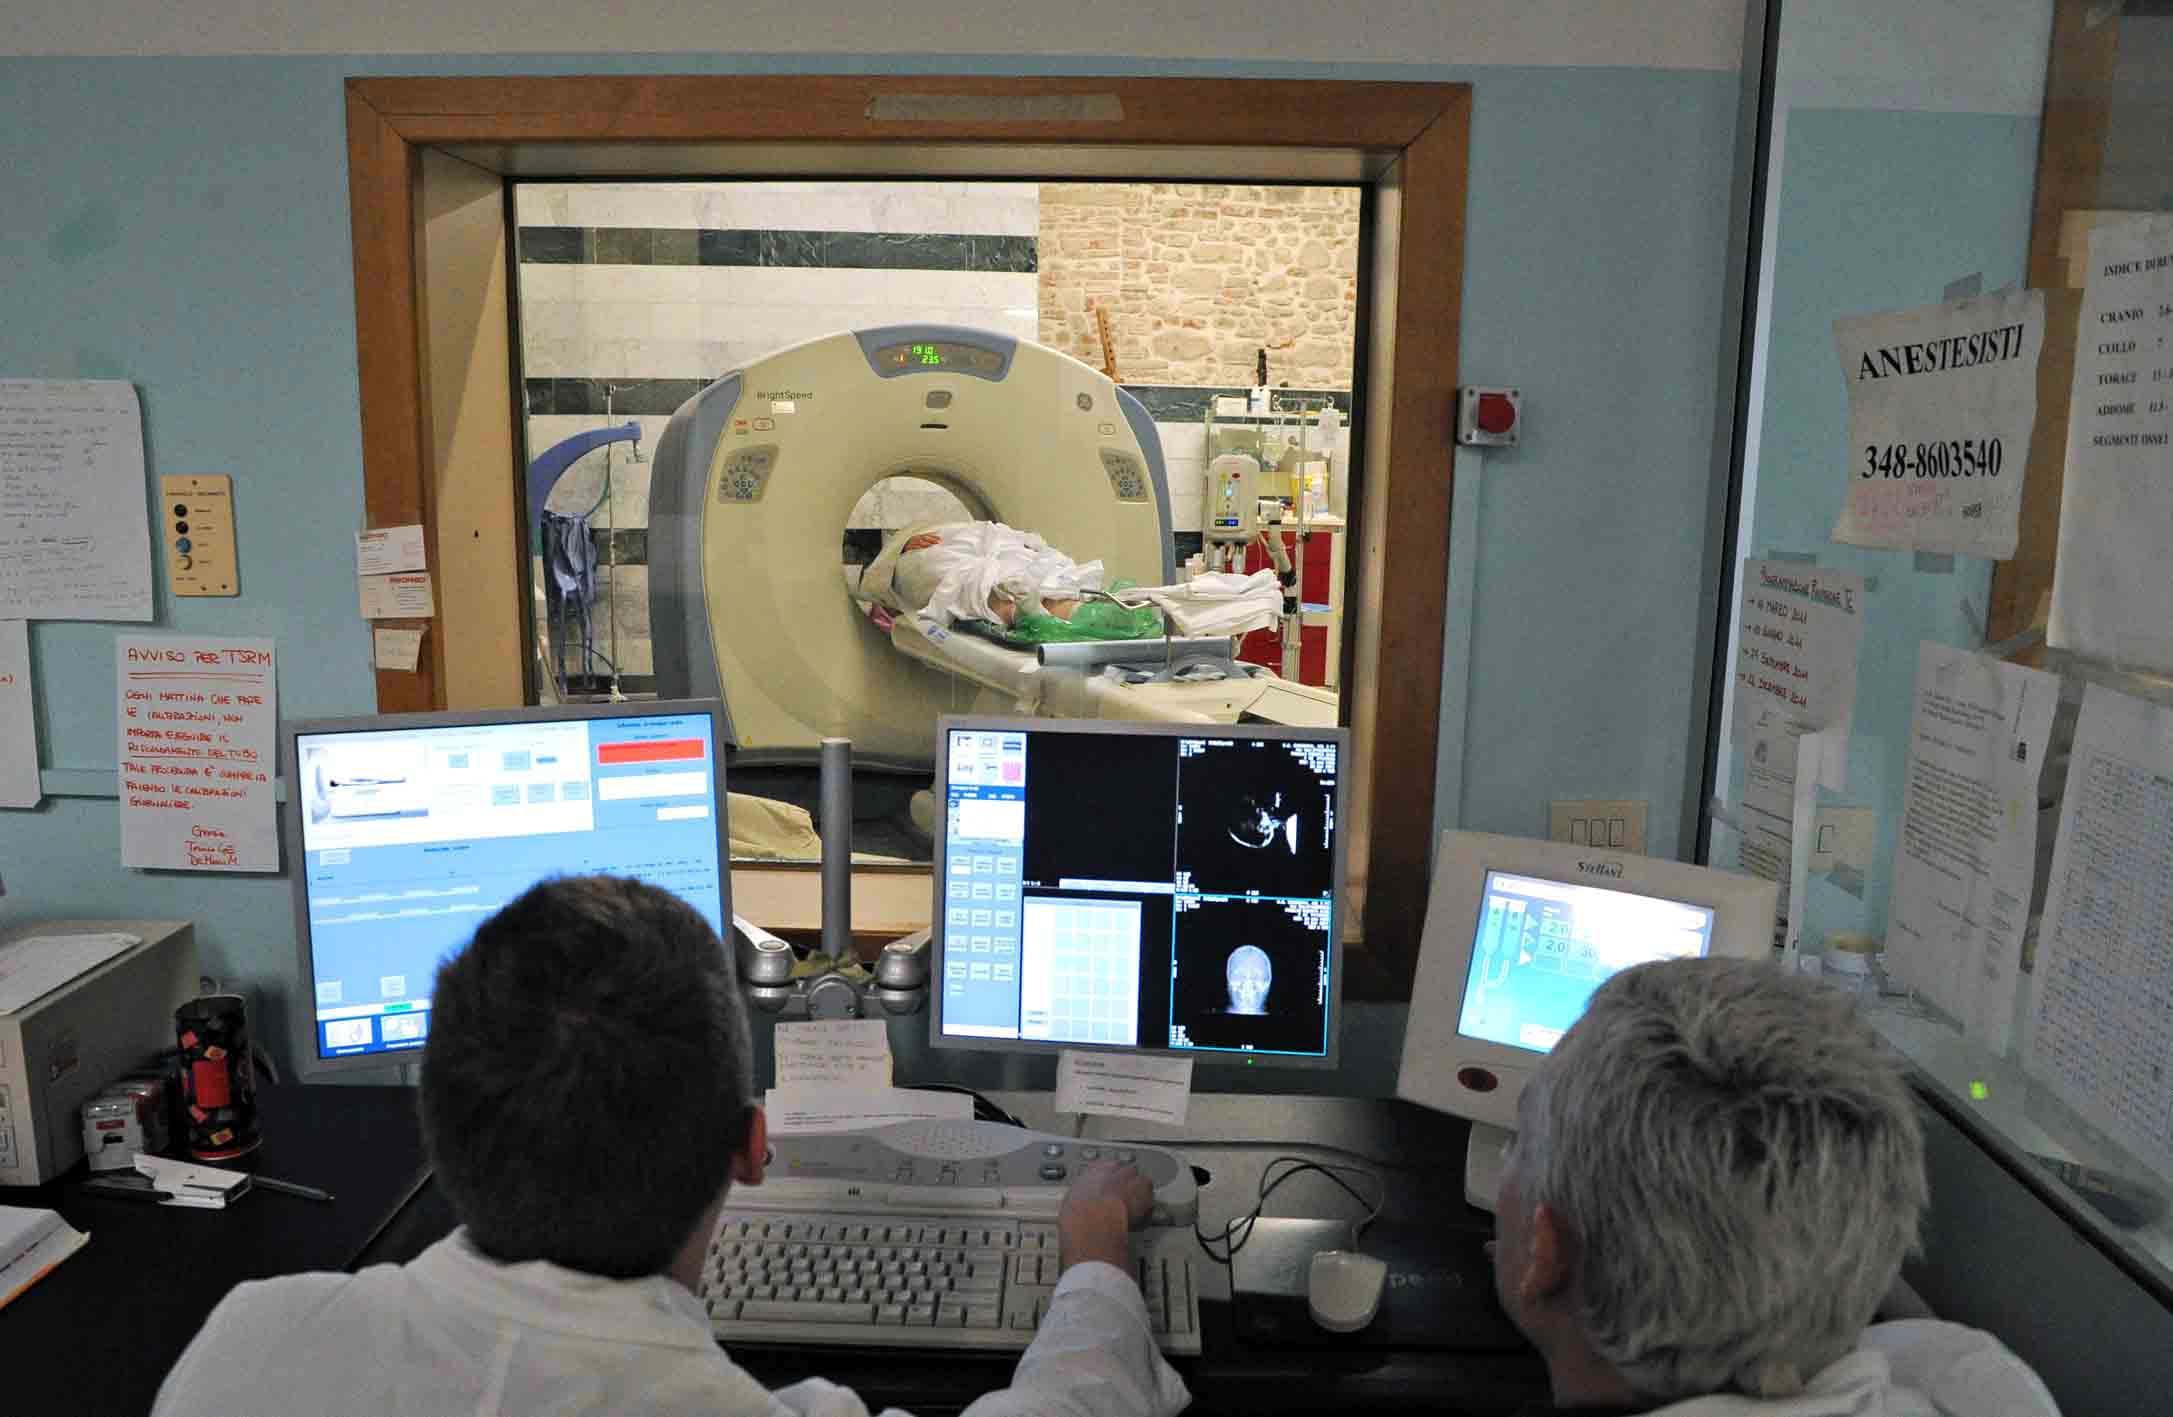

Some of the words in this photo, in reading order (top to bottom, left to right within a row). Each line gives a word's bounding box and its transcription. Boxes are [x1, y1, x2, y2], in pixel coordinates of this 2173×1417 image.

[1858, 324, 2024, 380] ANESTESISTI
[756, 391, 813, 401] BrightSpeed
[1862, 438, 2003, 479] 348-8603540
[128, 648, 185, 663] AVVISO
[192, 651, 221, 664] PER
[222, 650, 271, 667] TSRM
[126, 690, 152, 701] OGNI
[159, 690, 205, 702] MATTINA
[210, 694, 231, 704] CHE
[223, 715, 243, 723] NON
[121, 762, 145, 774] TALE
[151, 764, 198, 776] PROCEDURA
[126, 781, 165, 793] FACENDO
